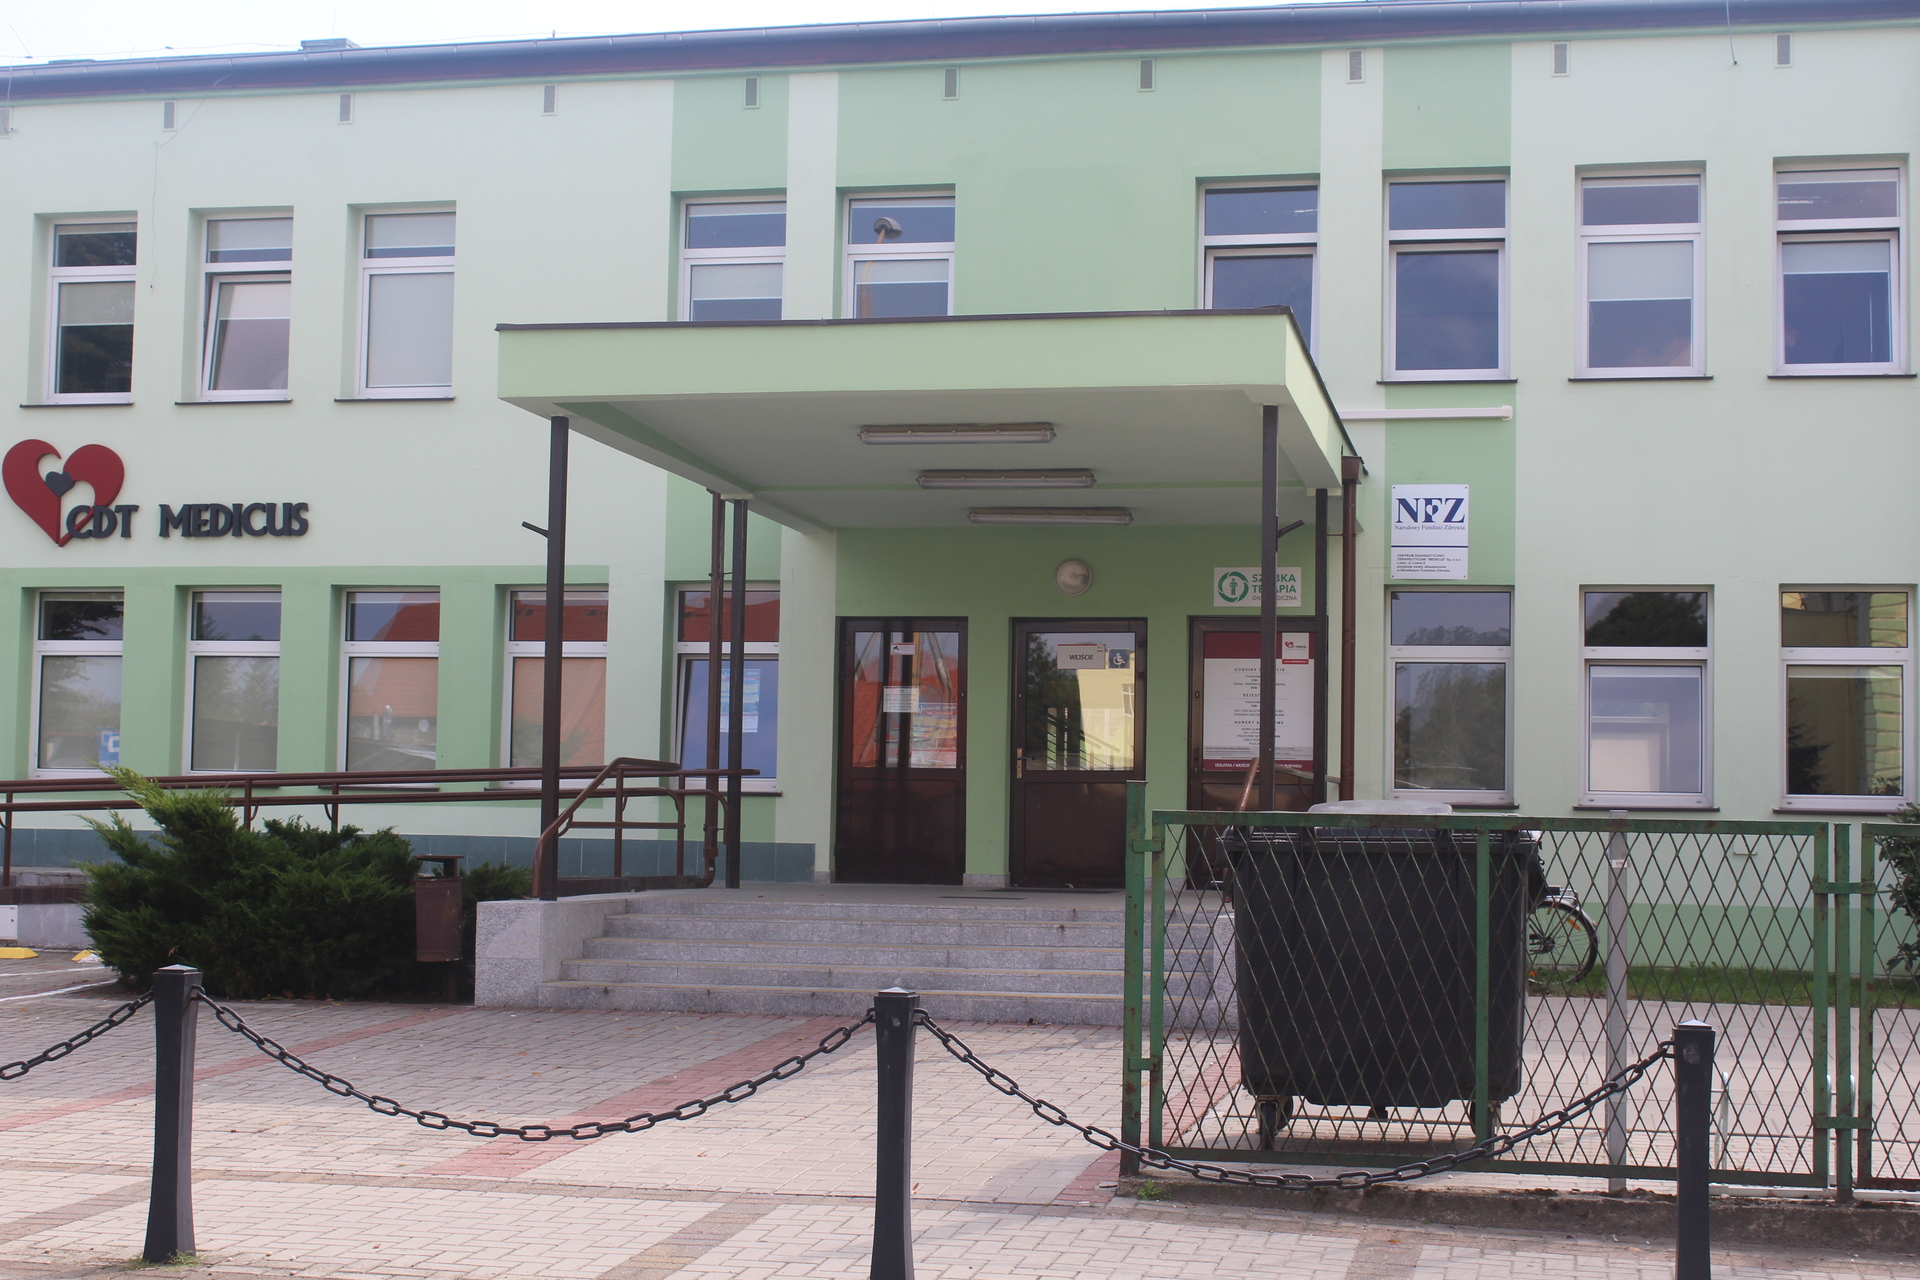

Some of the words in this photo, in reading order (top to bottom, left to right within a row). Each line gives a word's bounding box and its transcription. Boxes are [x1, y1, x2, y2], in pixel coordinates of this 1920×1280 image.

[66, 504, 140, 539] CDT
[159, 502, 310, 538] MEDICUS
[1395, 497, 1465, 523] NFZ
[1252, 585, 1297, 593] TEPIA
